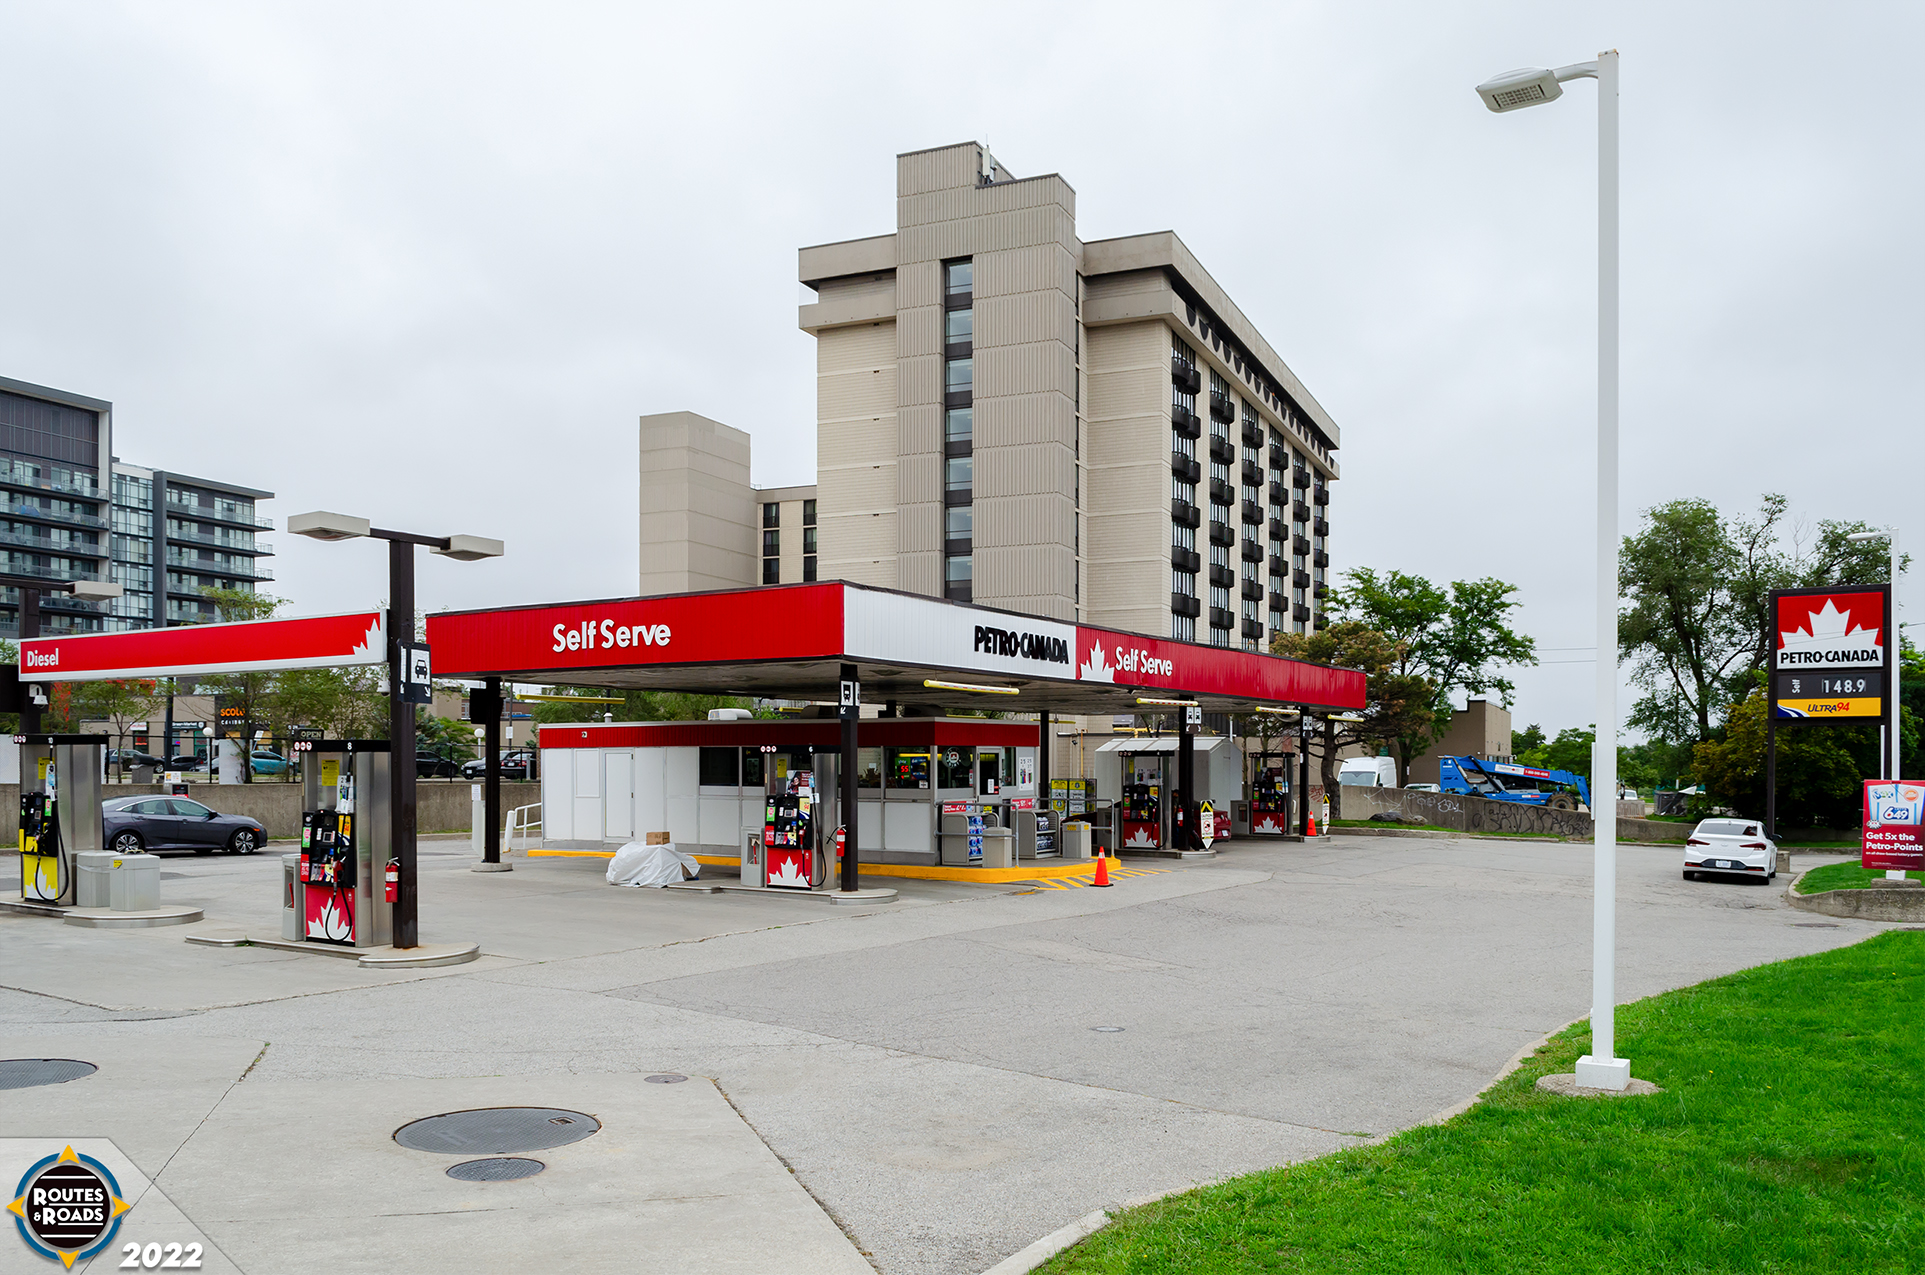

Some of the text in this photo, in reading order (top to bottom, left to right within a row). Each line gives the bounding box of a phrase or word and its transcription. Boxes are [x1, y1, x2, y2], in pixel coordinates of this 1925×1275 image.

[552, 618, 672, 653] Self Serve
[27, 647, 59, 667] Diesel
[1115, 646, 1173, 677] Self Serve
[1791, 679, 1801, 694] Self
[1824, 678, 1866, 694] 148.9
[347, 741, 352, 751] 8
[1866, 831, 1915, 841] Get 5x the
[1866, 842, 1924, 852] Petro-Points
